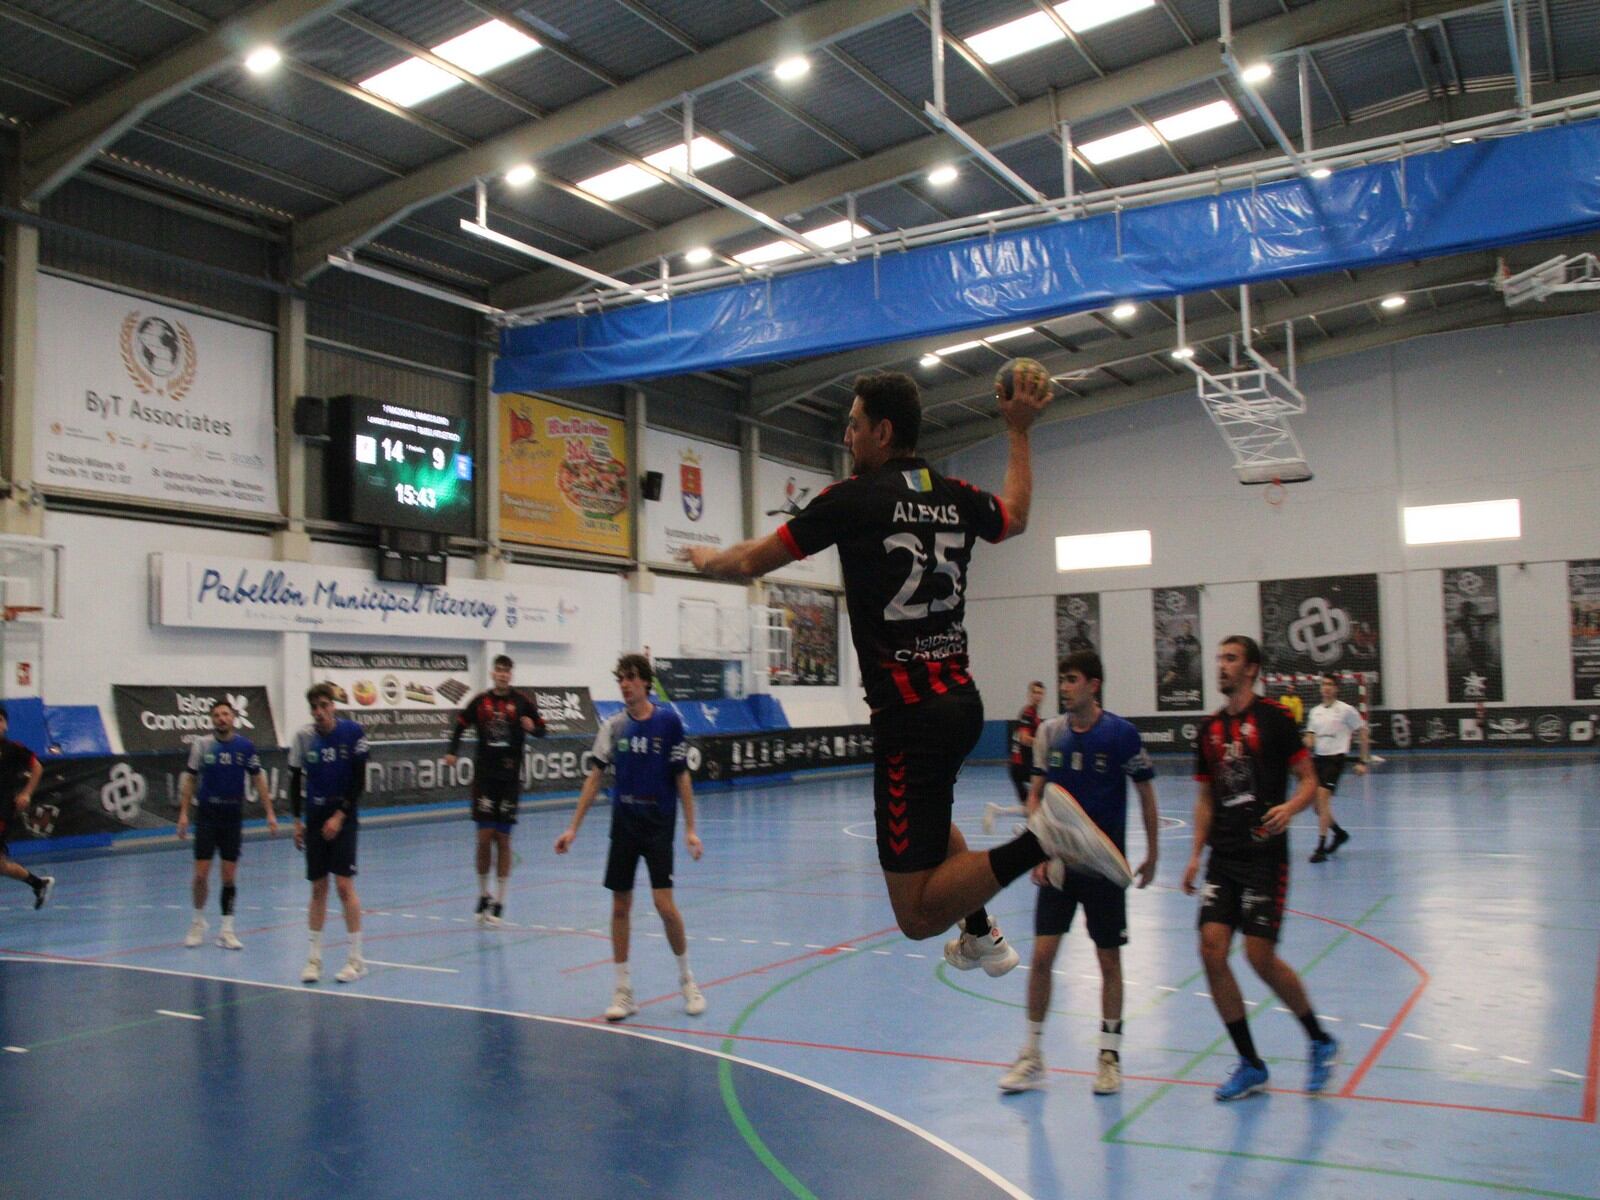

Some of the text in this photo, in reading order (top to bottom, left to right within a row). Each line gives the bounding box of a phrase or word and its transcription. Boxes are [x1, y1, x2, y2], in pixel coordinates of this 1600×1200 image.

[85, 390, 122, 420] ByT
[129, 399, 232, 437] Associates
[381, 437, 405, 463] 14
[432, 447, 445, 470] 9
[892, 501, 960, 524] ALEXIS
[882, 532, 966, 621] 25
[198, 569, 498, 628] Pabellón Municipal Titerroy
